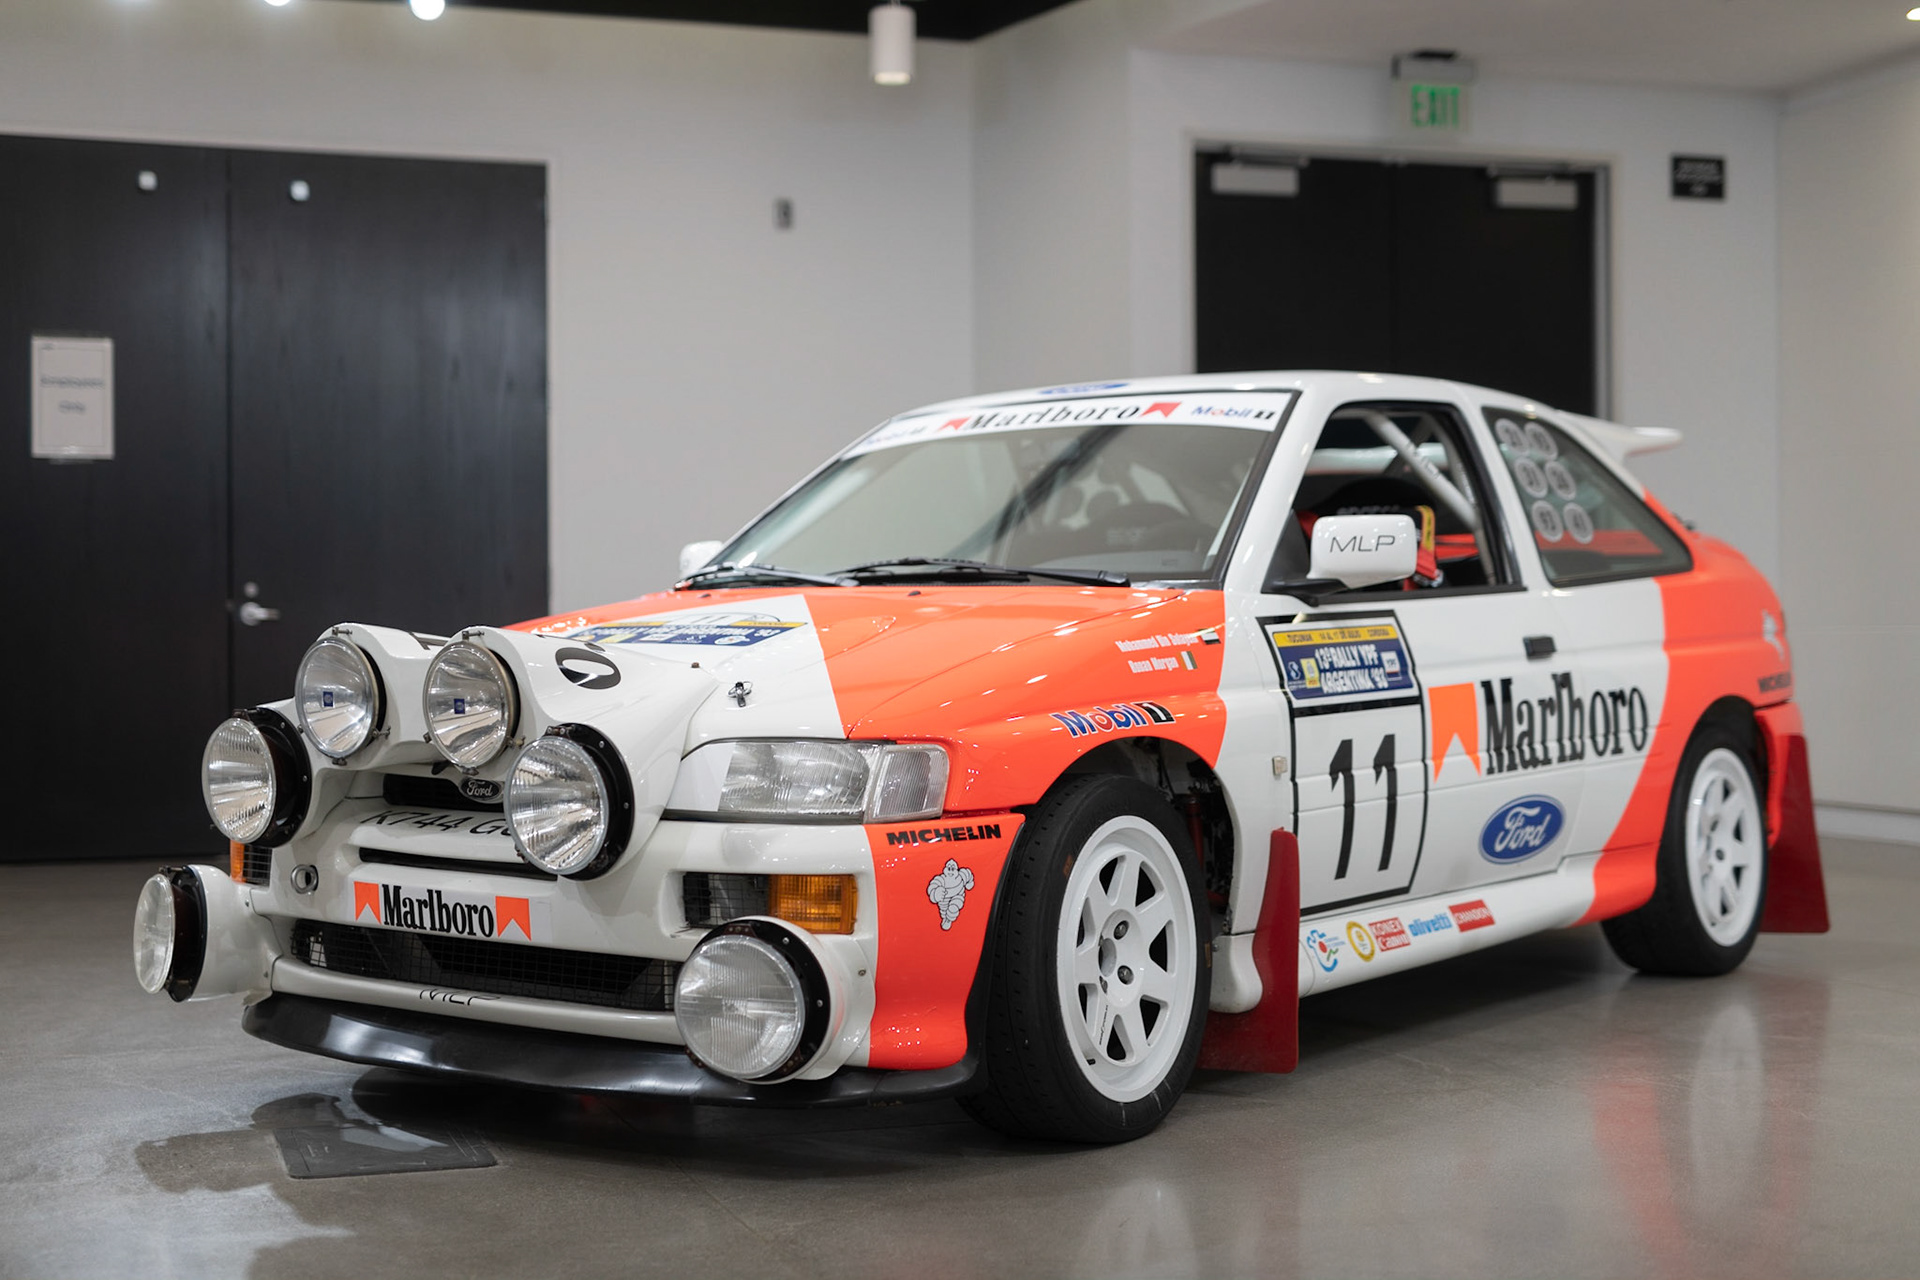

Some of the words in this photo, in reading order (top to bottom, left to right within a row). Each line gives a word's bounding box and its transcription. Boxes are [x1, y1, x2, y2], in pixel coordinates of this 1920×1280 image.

[1411, 85, 1459, 127] EXIT
[963, 405, 1140, 430] Marlboro
[1330, 535, 1396, 552] MLP
[1330, 645, 1361, 668] RALLY
[1320, 668, 1375, 694] ARGENTINA
[1051, 703, 1147, 737] Mobil
[1481, 672, 1648, 775] Marlboro
[466, 780, 493, 797] Ford
[1330, 733, 1397, 880] 11
[360, 811, 473, 831] K744
[1494, 807, 1551, 853] Ford
[886, 824, 1001, 845] MICHELIN
[382, 884, 494, 938] Marlboro
[1408, 912, 1453, 937] olivetti
